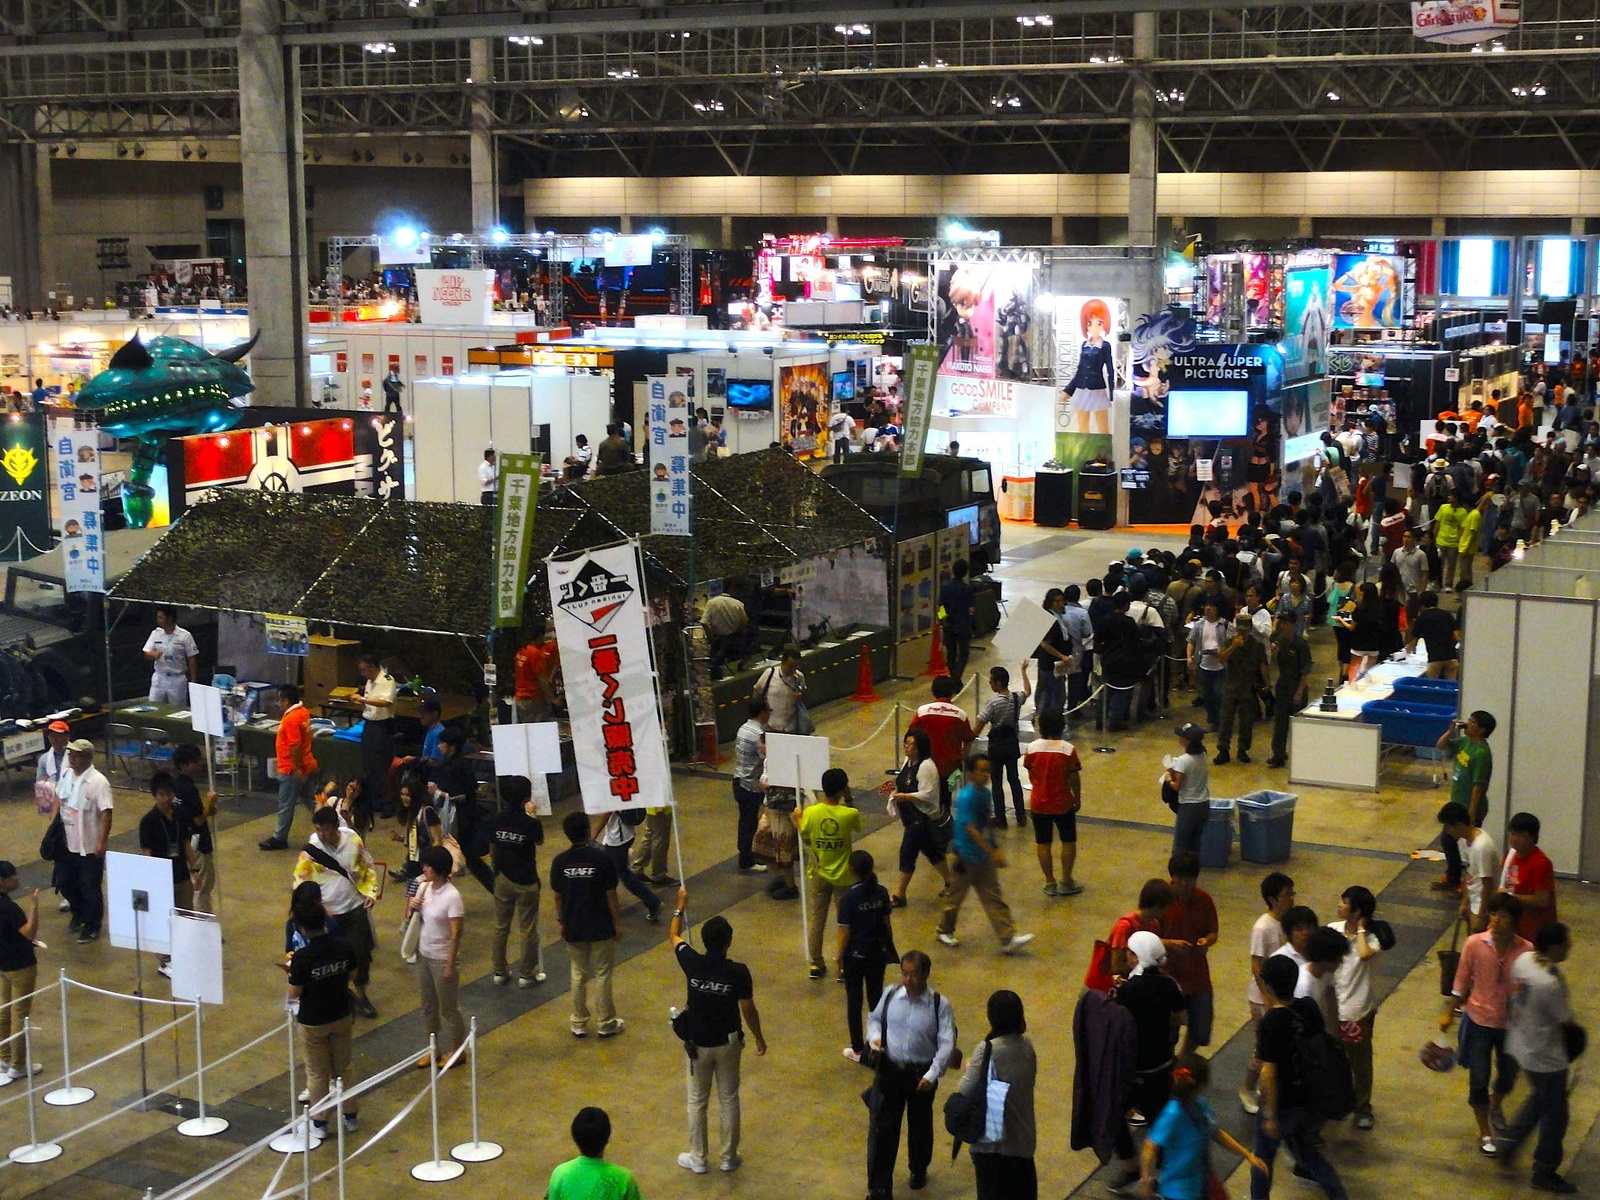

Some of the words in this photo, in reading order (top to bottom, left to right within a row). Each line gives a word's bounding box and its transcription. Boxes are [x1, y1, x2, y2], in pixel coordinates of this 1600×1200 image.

[540, 355, 589, 365] FLEX
[1174, 356, 1215, 366] ULTRA
[1184, 369, 1249, 379] PICTURES
[951, 383, 978, 396] GOOD
[978, 380, 1013, 401] SMILE
[0, 490, 42, 501] ZEON
[501, 479, 525, 611] 千葉地方協力本部
[495, 830, 527, 842] STAFF
[815, 840, 845, 849] STAFF
[563, 867, 597, 877] STAFF
[311, 959, 350, 978] STAFF
[690, 978, 733, 993] STAFF
